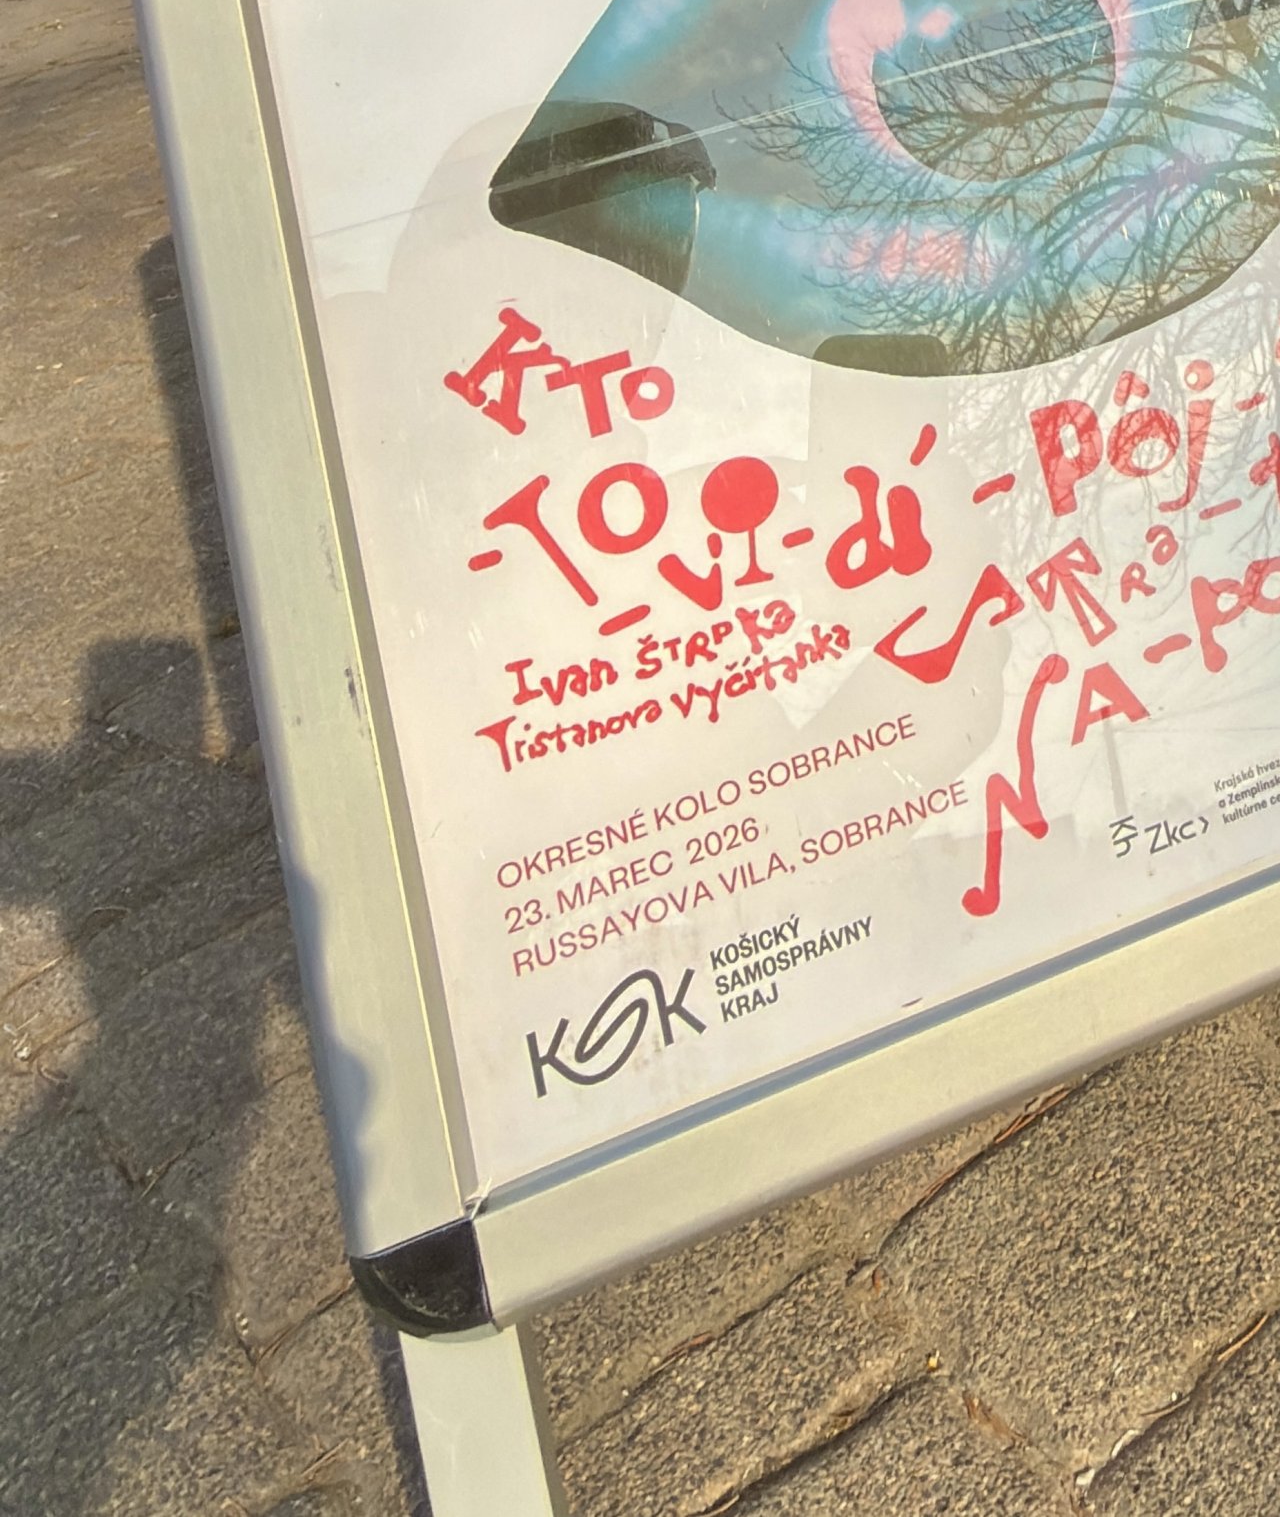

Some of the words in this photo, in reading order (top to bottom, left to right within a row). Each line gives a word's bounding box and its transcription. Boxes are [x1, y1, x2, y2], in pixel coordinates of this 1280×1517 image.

[504, 657, 618, 707] Ivan
[474, 698, 663, 772] Tristanova
[496, 809, 649, 889] OKRESNÉ
[653, 779, 741, 832] KOLO
[748, 713, 918, 796] SOBRANCE
[1213, 768, 1256, 794] Krajská
[1221, 796, 1269, 825] kultúrne
[503, 900, 552, 934] 23.
[556, 850, 674, 914] MAREC
[686, 817, 761, 865] 2026
[511, 880, 714, 978] RUSSAYOVA
[718, 851, 797, 896] VILA,
[800, 780, 970, 866] SOBRANCE
[709, 914, 802, 971] KOŠICKÝ
[715, 916, 874, 997] SAMOSPRÁVNY
[720, 982, 780, 1023] KRAJ
